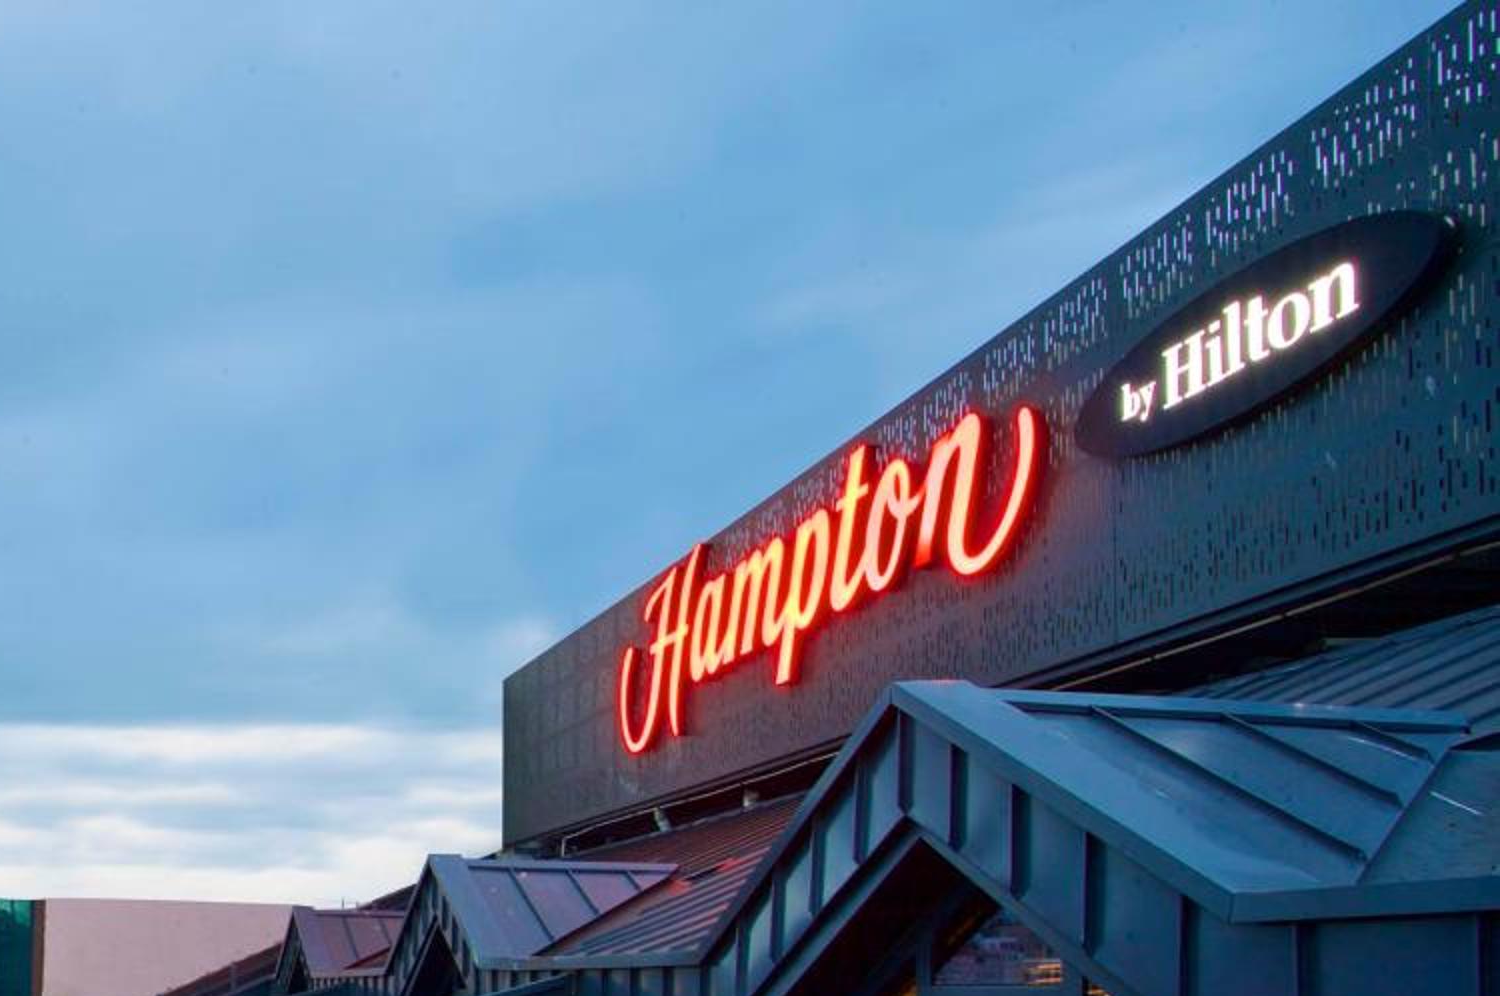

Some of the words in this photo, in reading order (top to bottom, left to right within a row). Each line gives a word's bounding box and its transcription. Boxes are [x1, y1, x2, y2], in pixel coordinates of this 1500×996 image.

[1120, 380, 1158, 422] by
[1161, 260, 1361, 411] Hilton
[617, 404, 1040, 756] Hampton
